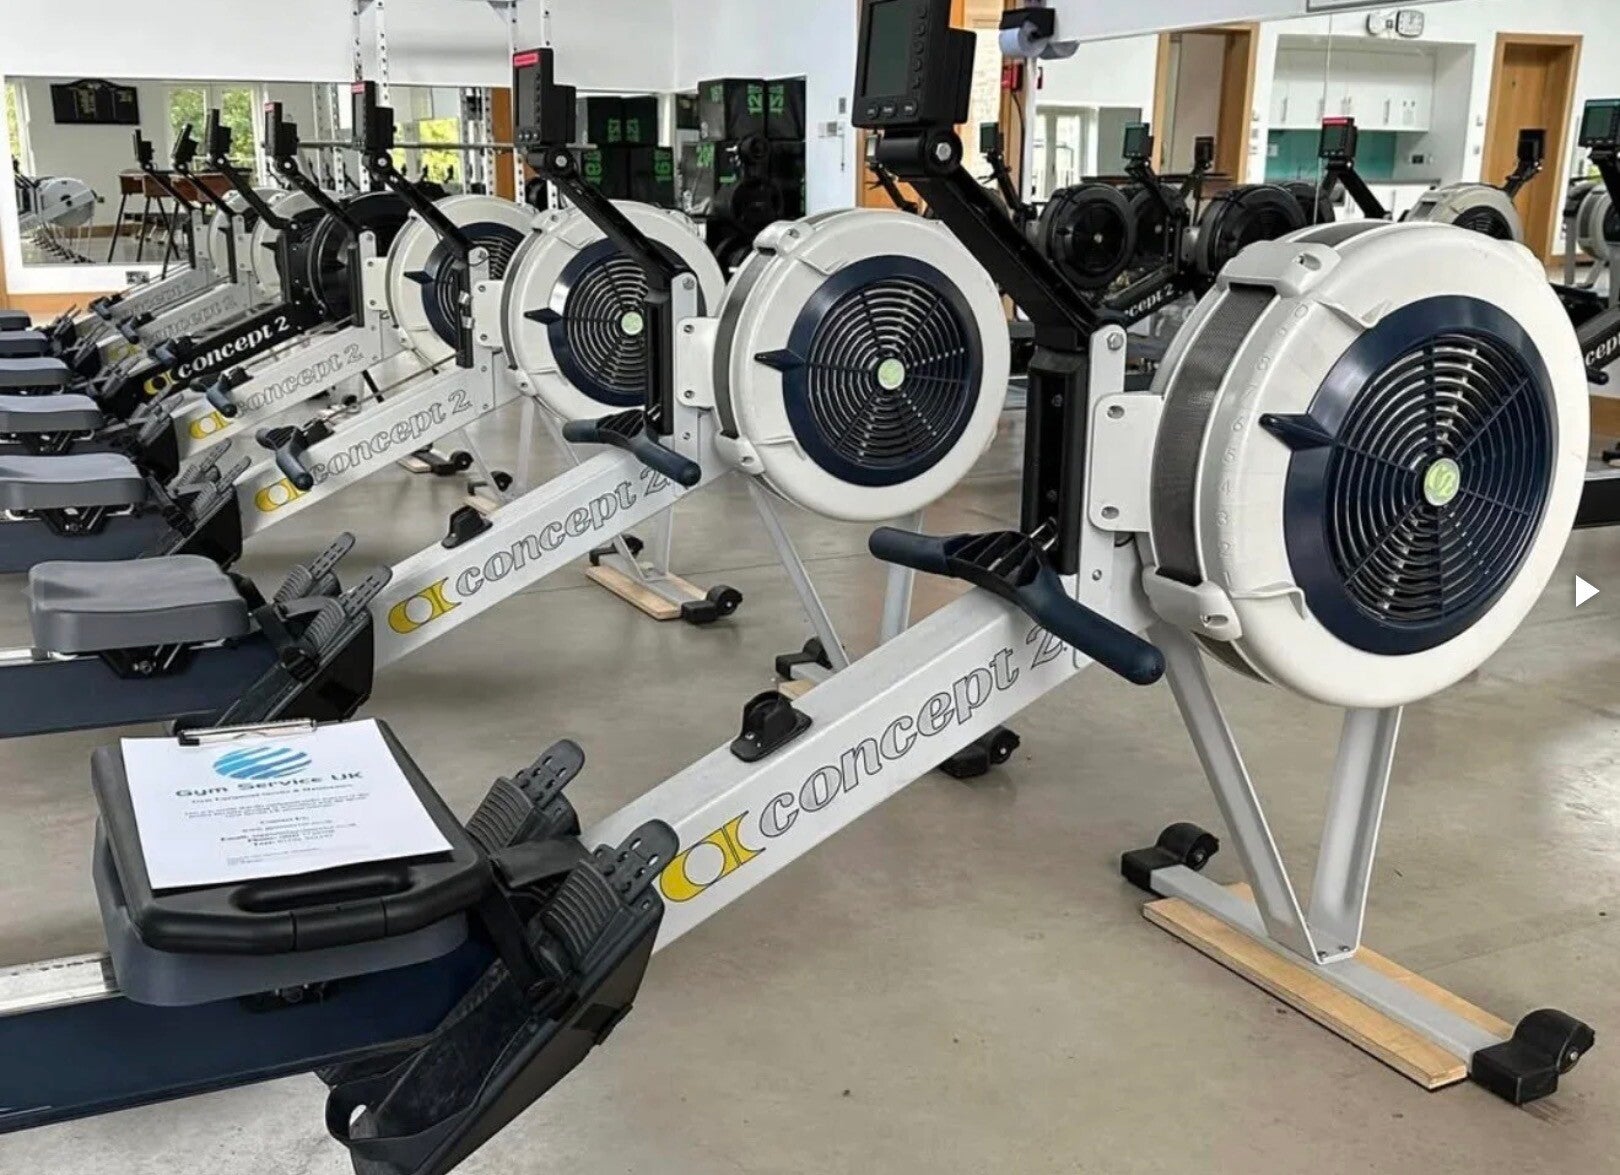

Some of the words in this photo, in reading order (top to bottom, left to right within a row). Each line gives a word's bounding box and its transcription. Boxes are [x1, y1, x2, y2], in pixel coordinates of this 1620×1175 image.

[1164, 283, 1174, 296] 2
[178, 324, 274, 379] concept
[274, 315, 291, 332] 2
[344, 343, 363, 364] 2
[1586, 331, 1620, 366] cep
[448, 389, 470, 414] 2
[455, 480, 637, 597] concept
[639, 466, 670, 497] 2
[759, 646, 1020, 838] concept
[175, 786, 228, 797] Gym
[237, 777, 322, 791] Service
[330, 771, 363, 781] UK
